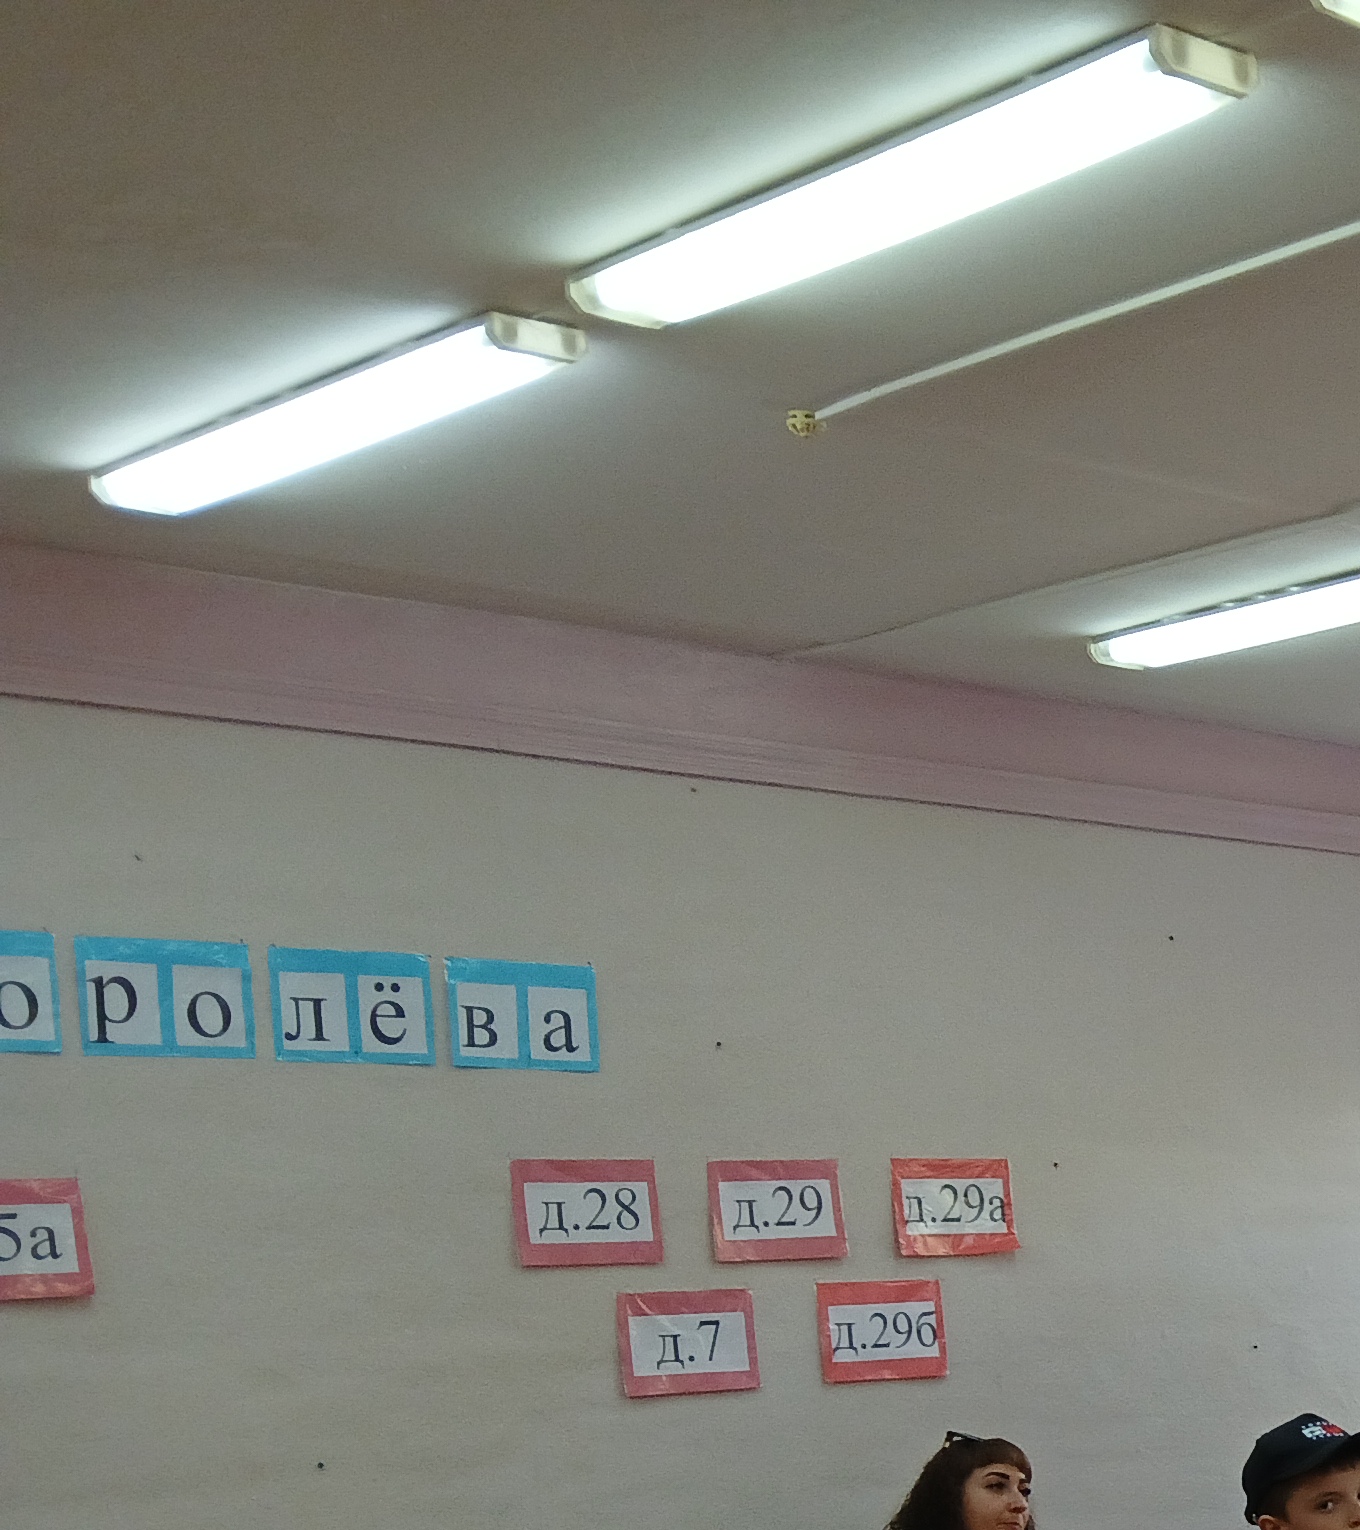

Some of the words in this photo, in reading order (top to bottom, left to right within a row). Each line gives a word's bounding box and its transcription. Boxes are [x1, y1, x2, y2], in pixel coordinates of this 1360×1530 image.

[538, 1186, 641, 1238] д.28
[731, 1184, 824, 1235] д.29
[903, 1183, 1006, 1226] д.29а
[655, 1319, 721, 1370] д.7
[831, 1310, 938, 1357] д.29б
